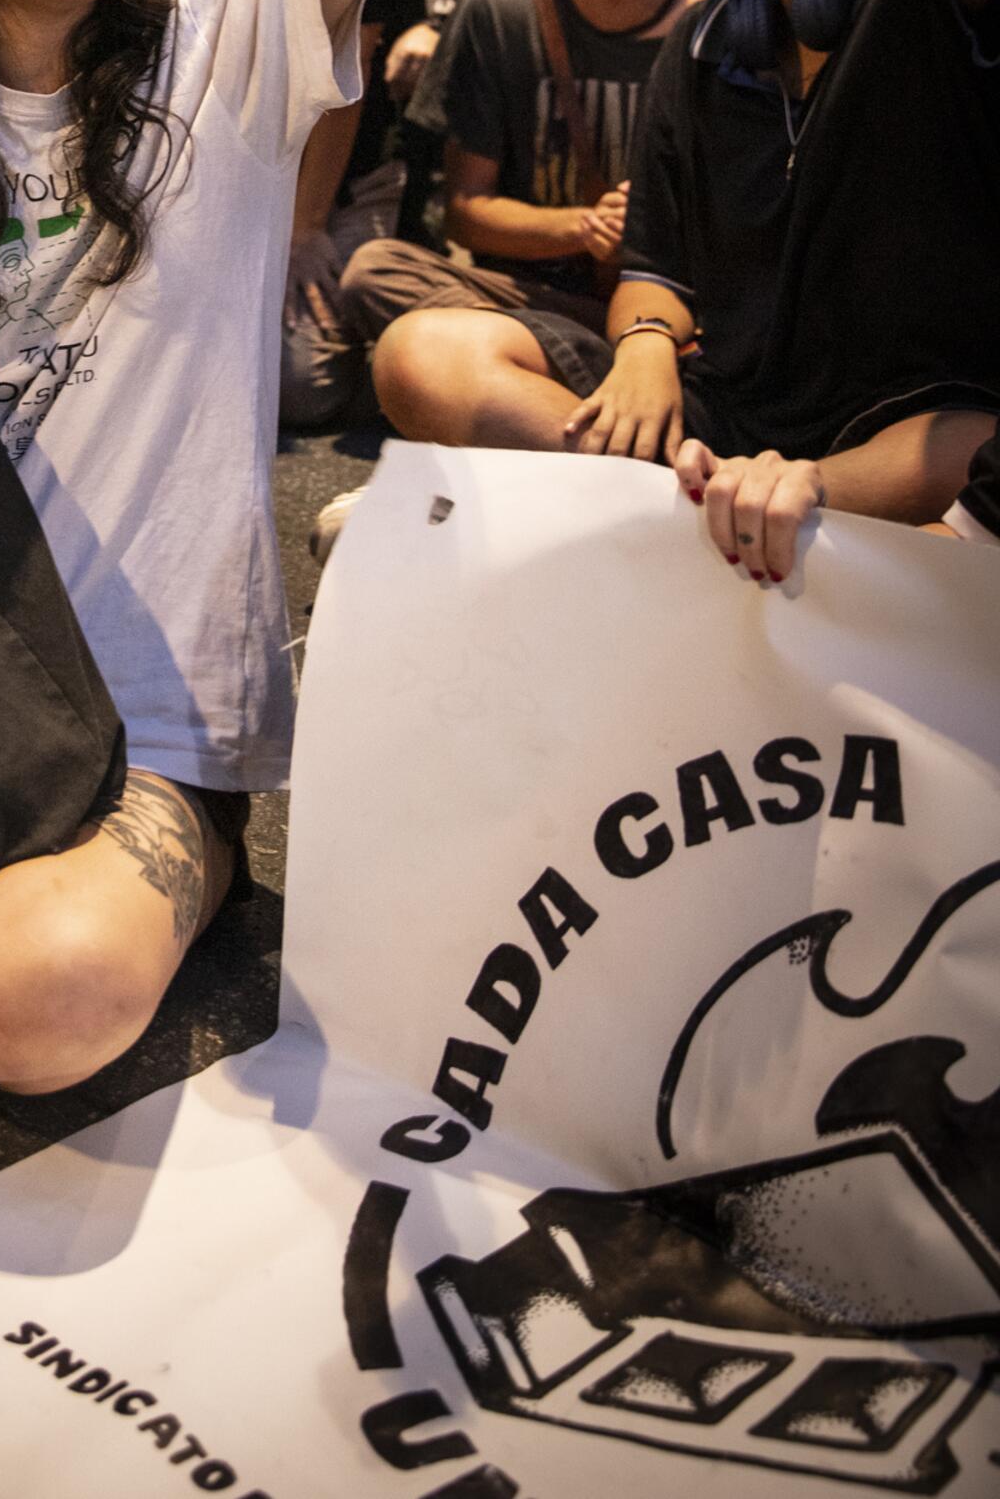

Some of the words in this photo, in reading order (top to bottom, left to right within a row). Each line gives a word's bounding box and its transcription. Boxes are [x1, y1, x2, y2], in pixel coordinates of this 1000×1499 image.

[380, 866, 599, 1163] CADA
[594, 734, 905, 879] CASA
[3, 1321, 237, 1492] SINDICATO
